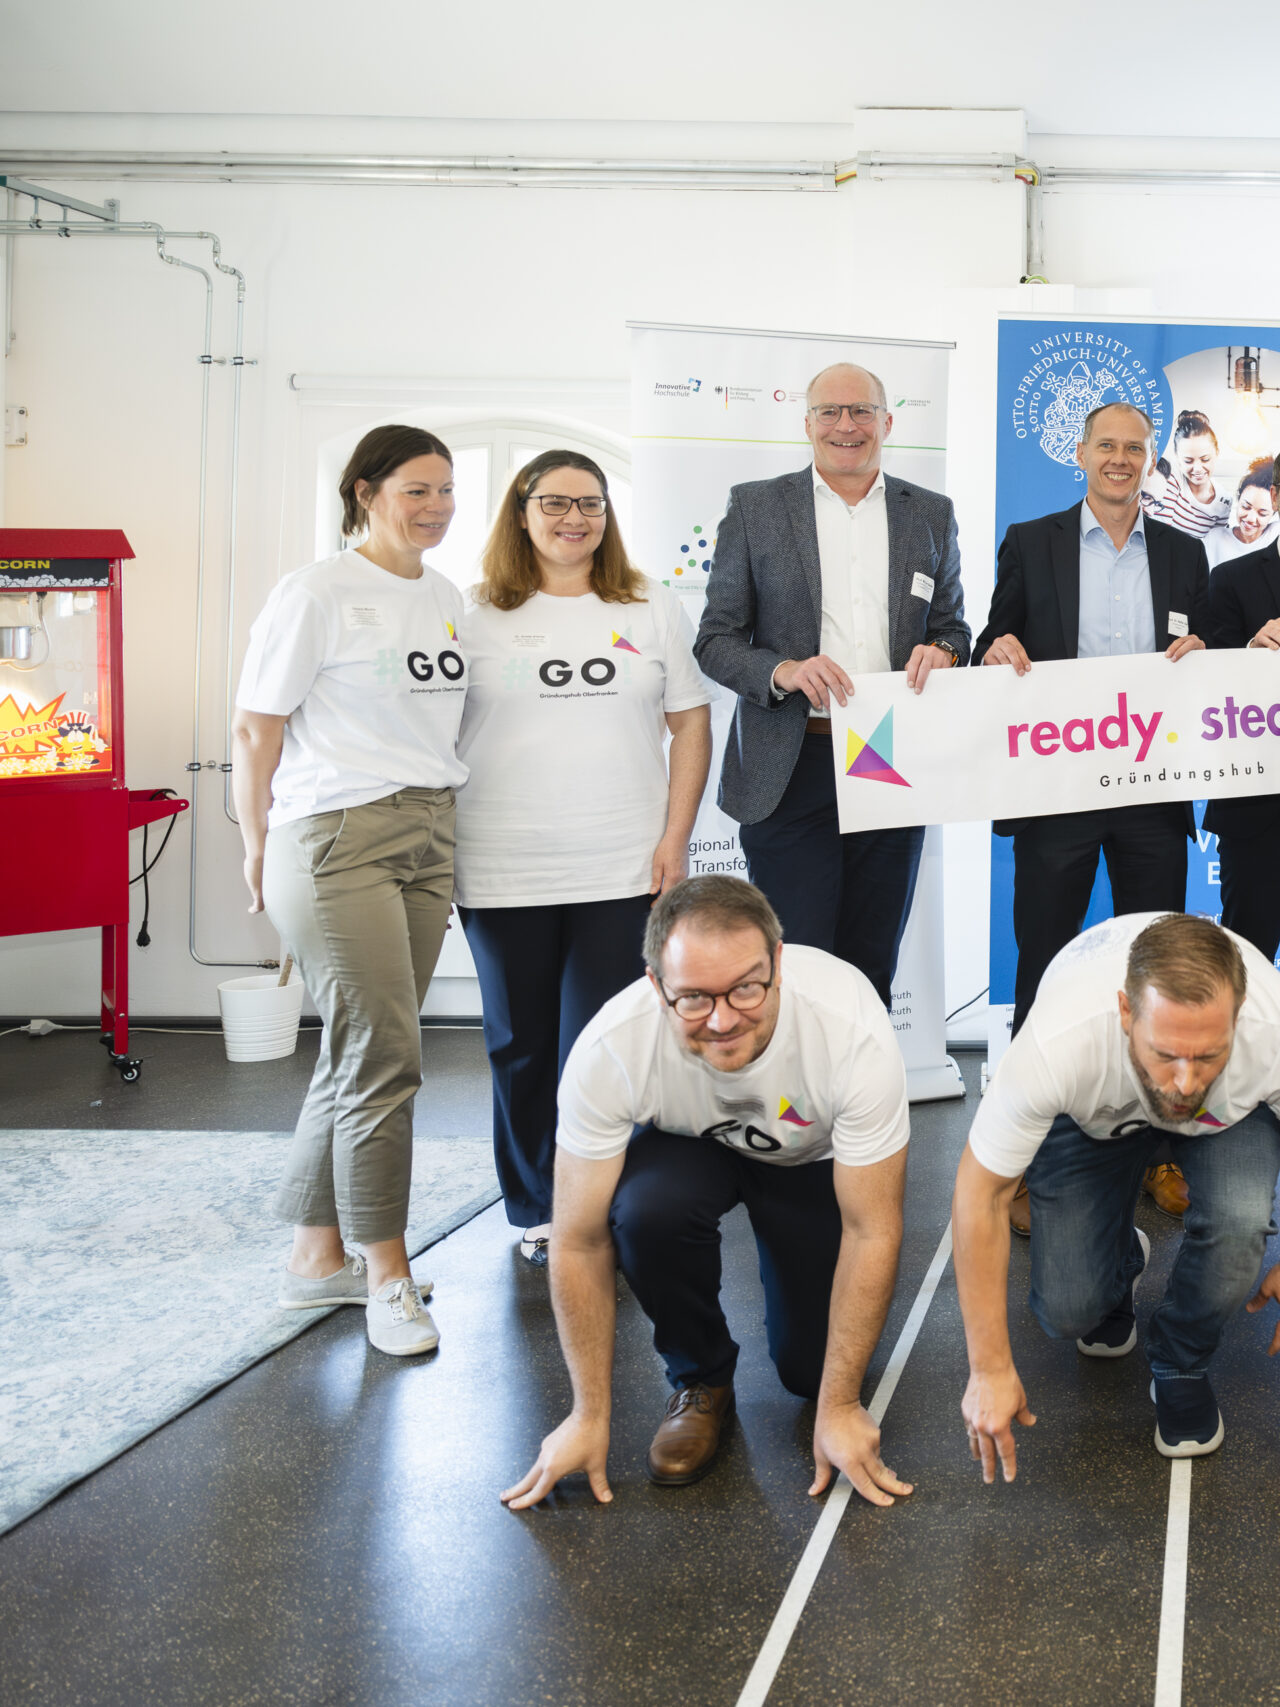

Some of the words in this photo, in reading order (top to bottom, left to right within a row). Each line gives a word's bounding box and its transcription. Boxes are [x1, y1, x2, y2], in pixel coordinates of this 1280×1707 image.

[654, 389, 691, 398] Hochschule
[655, 382, 691, 391] Innovative
[1030, 331, 1133, 358] UNIVERSITY
[1132, 359, 1148, 376] OF
[1145, 379, 1165, 449] BAMBE
[1008, 692, 1178, 762] ready.
[1100, 762, 1265, 787] Gründungshub
